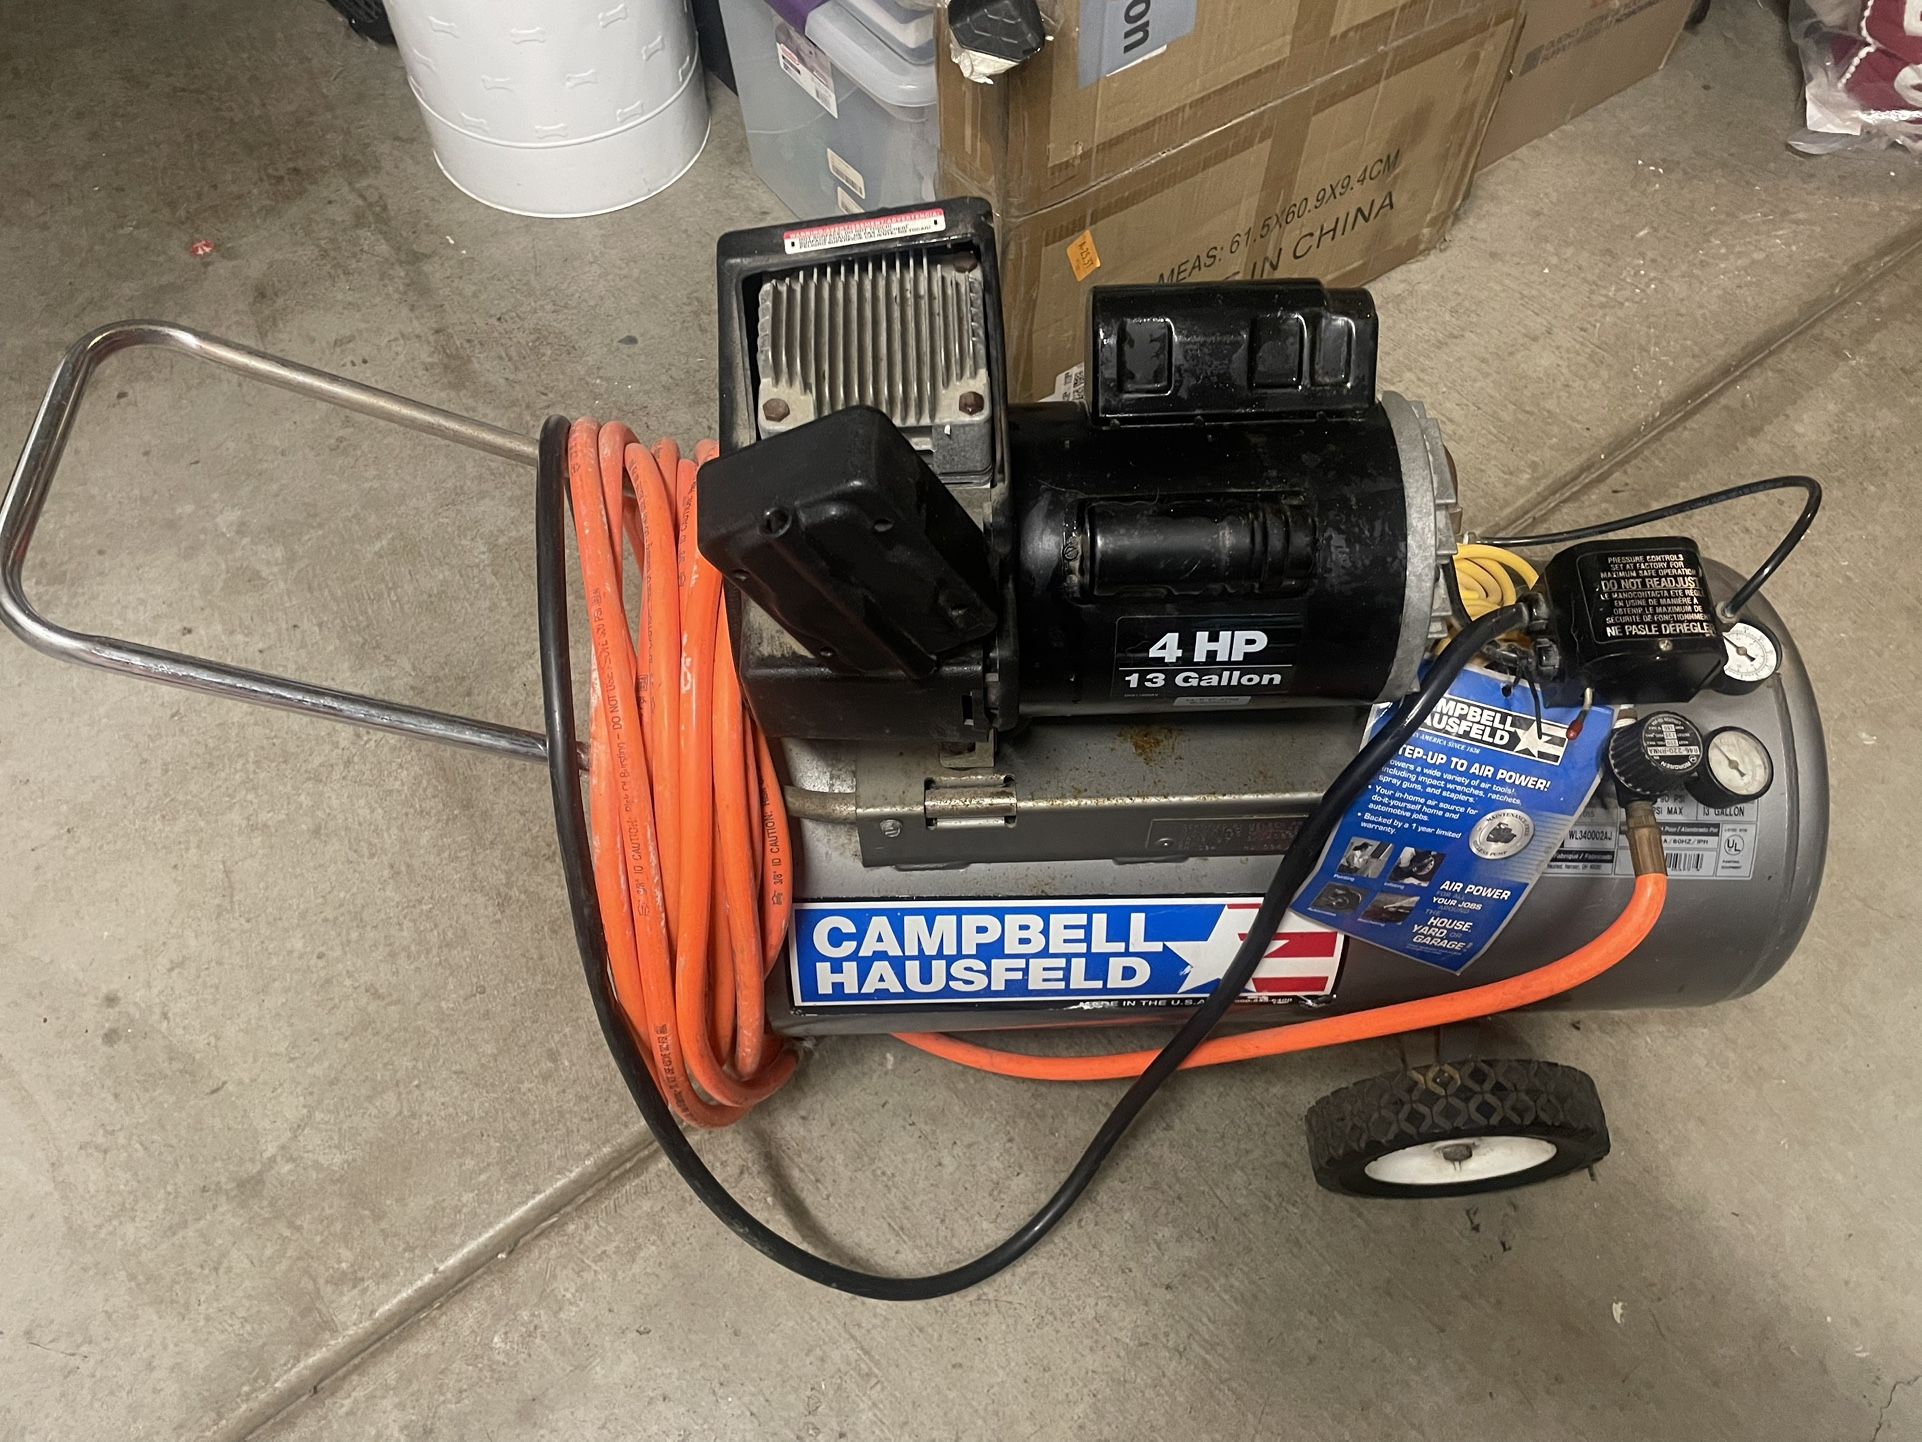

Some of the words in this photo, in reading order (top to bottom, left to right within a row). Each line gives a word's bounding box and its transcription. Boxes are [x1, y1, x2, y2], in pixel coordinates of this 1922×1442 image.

[1250, 247, 1283, 280] IN
[1293, 191, 1395, 260] CHINA
[1158, 246, 1224, 283] MEAS:
[1608, 556, 1645, 564] PRESSURE
[1646, 554, 1684, 562] CONTROLS
[1636, 561, 1667, 570] FACTORY
[1670, 561, 1685, 569] FOR
[1600, 570, 1637, 579] MAXIMUM
[1638, 569, 1657, 577] SAFE
[1658, 568, 1697, 576] OPERATION
[1601, 580, 1618, 591] DO
[1621, 578, 1643, 590] NOT
[1645, 576, 1699, 589] READJUST
[1614, 600, 1624, 608] EN
[1626, 599, 1648, 608] USINE
[1648, 598, 1658, 606] DE
[1645, 606, 1654, 614] LE
[1656, 605, 1693, 613] MAXIMUM
[1693, 605, 1703, 613] DE
[1606, 625, 1623, 637] NE
[1149, 632, 1182, 663] 4
[1194, 631, 1268, 662] HP
[1125, 673, 1166, 688] 13
[1175, 671, 1282, 687] Gallon
[1434, 701, 1516, 732] MPBELL
[1389, 759, 1415, 772] owers
[1423, 764, 1442, 777] wide
[1443, 772, 1470, 787] variety
[1471, 779, 1480, 787] of
[1480, 781, 1492, 790] air
[1398, 744, 1447, 765] TEP-UP
[1450, 757, 1467, 771] TO
[1469, 762, 1494, 778] AIR
[1496, 768, 1552, 792] POWER!
[1378, 774, 1402, 788] spray
[1402, 780, 1424, 792] guns,
[1425, 784, 1442, 796] and
[1418, 774, 1446, 788] impact
[1446, 781, 1485, 798] wrenches,
[1371, 793, 1422, 811] do-it-yourself
[1422, 805, 1444, 817] home
[1444, 810, 1460, 821] and
[1375, 784, 1394, 797] Your
[1395, 790, 1427, 805] in-home
[1427, 797, 1438, 806] air
[1438, 801, 1466, 813] source
[1466, 806, 1479, 815] for
[1368, 802, 1411, 818] automotive
[1411, 811, 1430, 822] jobs.
[1666, 806, 1684, 816] MAX
[1702, 807, 1711, 817] 13
[1714, 805, 1745, 817] GALLON
[763, 811, 780, 853] CAUTION:
[1360, 821, 1397, 835] warranty.
[1363, 812, 1393, 826] Backed
[1393, 818, 1402, 829] by
[1417, 825, 1435, 835] year
[1435, 826, 1462, 839] limited
[771, 858, 781, 866] ID
[1440, 880, 1464, 893] AIR
[1465, 883, 1511, 901] POWER
[1432, 896, 1458, 907] YOUR
[1458, 900, 1483, 911] JOBS
[812, 912, 1164, 959] CAMPBELL
[1412, 935, 1473, 952] GARAGE!
[815, 957, 1152, 995] HAUSFELD
[1141, 999, 1168, 1007] THE
